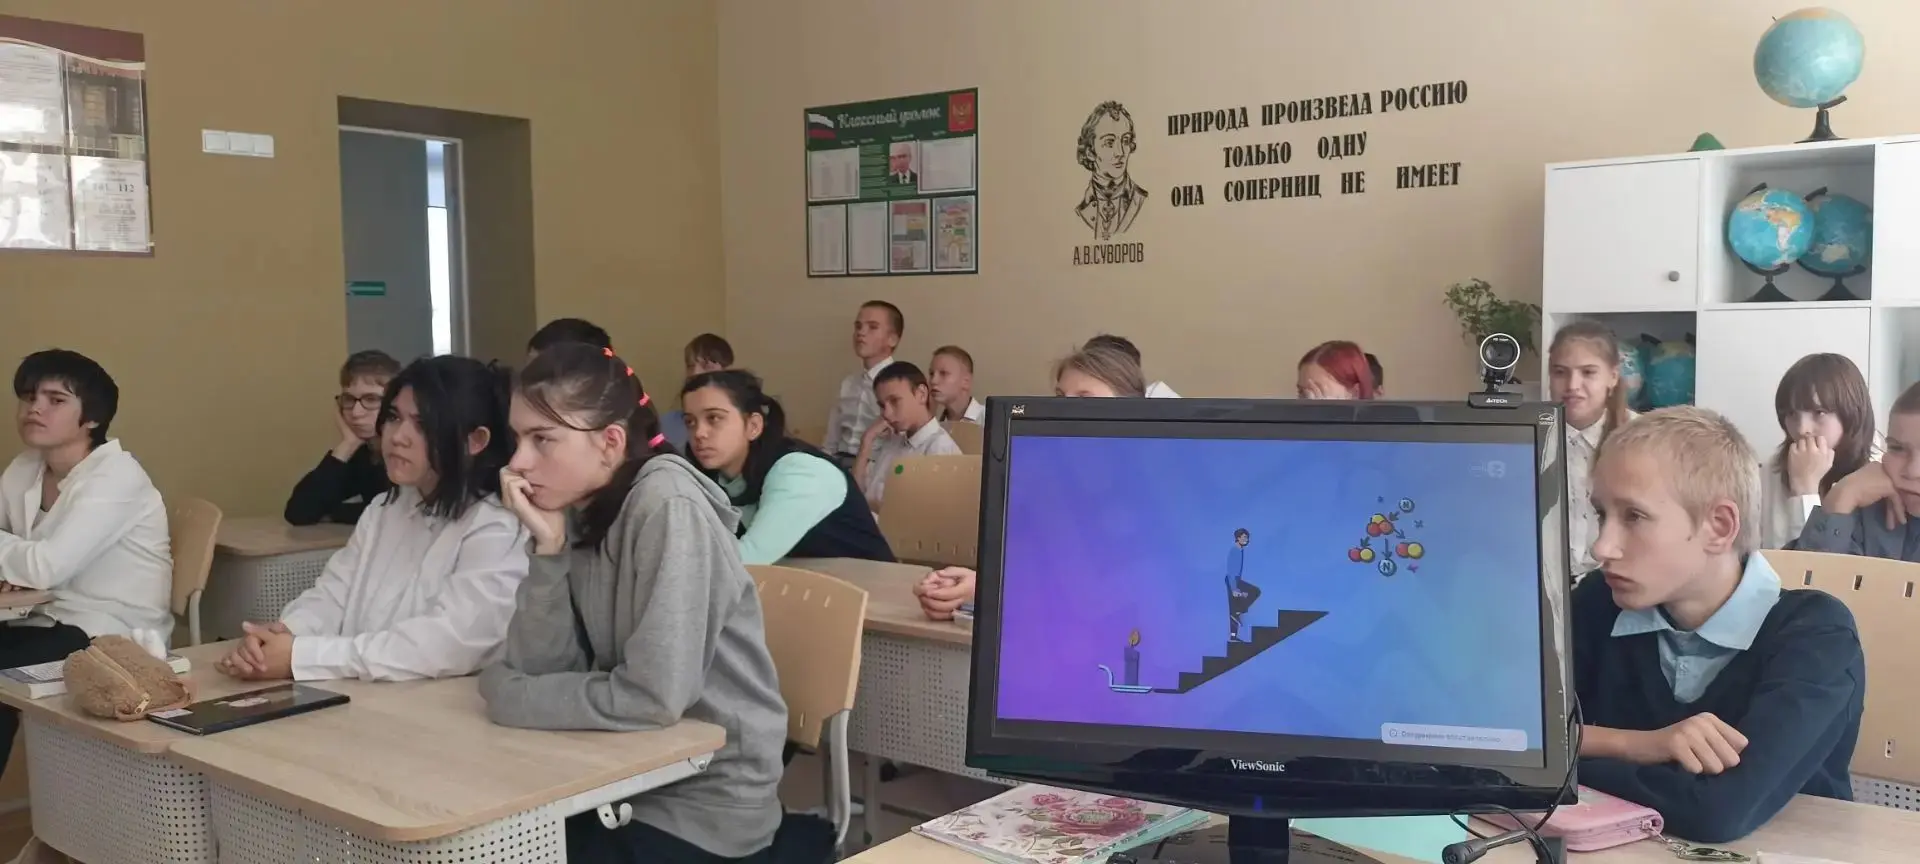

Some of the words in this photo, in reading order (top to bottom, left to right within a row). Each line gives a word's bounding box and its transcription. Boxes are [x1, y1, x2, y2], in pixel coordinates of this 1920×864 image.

[1167, 106, 1249, 136] ПРИРОДА
[1261, 92, 1372, 126] ПРОИЗВЕЛА
[1380, 79, 1468, 113] РОССИЮ
[1222, 141, 1292, 168] ТОЛЬКО
[1317, 132, 1368, 161] ОДНУ
[118, 184, 135, 193] 112
[1170, 184, 1205, 207] ОНА
[1223, 173, 1322, 202] СОПЕРНИЦ
[1340, 170, 1366, 194] НЕ
[1396, 162, 1462, 189] ИМЕЕТ
[1073, 242, 1145, 266] А.В.СУВОРОВ
[1230, 758, 1286, 772] ViewSonic
